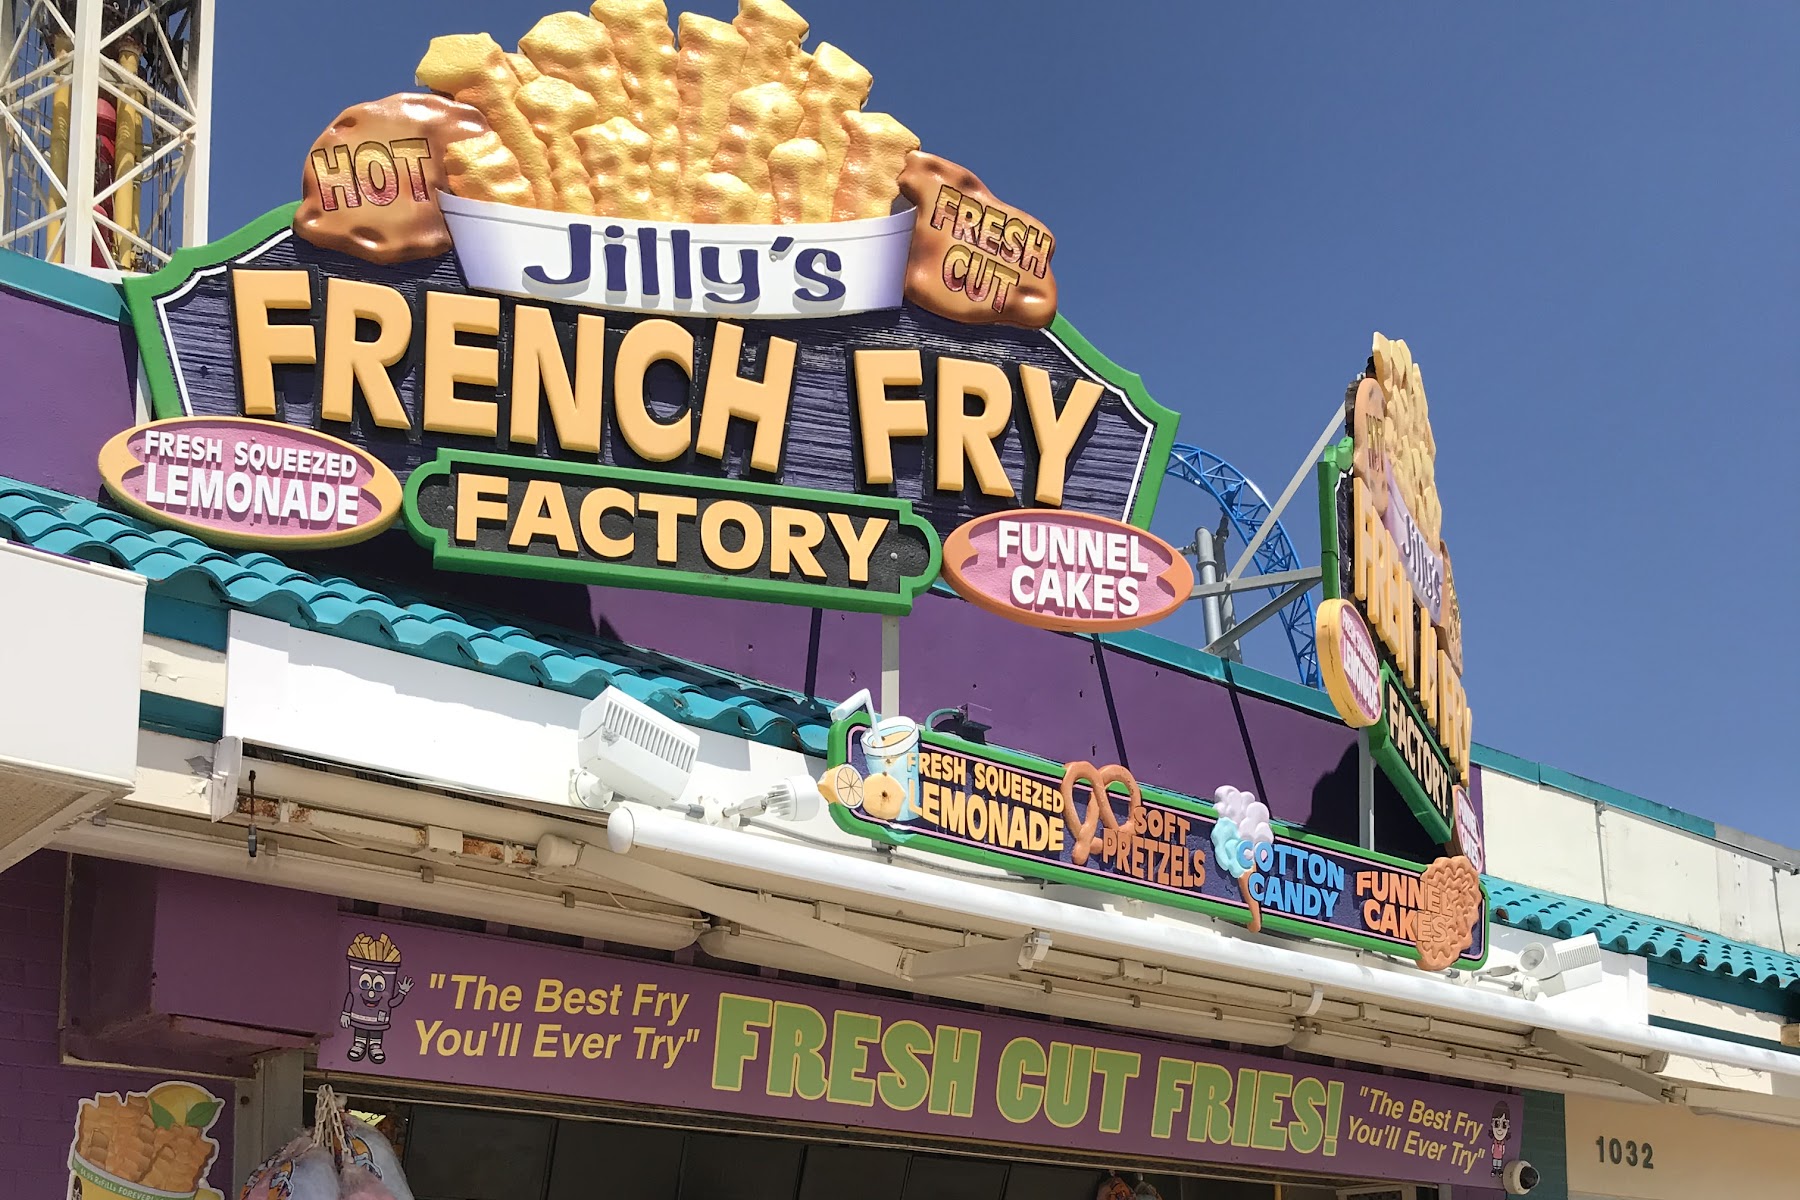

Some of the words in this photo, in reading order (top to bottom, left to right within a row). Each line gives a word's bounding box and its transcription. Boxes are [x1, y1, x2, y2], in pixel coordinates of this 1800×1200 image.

[311, 137, 432, 212] HOT
[930, 184, 1053, 280] FRESH
[523, 222, 847, 304] Jilly's
[942, 243, 1020, 314] CUT
[232, 268, 798, 474] FRENCH
[854, 349, 1105, 507] FRY
[144, 430, 223, 464] FRESH
[234, 440, 358, 480] SQUEEZED
[144, 461, 360, 526] LEMONADE
[455, 472, 890, 583] FACTORY
[998, 519, 1150, 574] FUNNEL
[1010, 569, 1140, 615] CAKES
[1388, 683, 1447, 818] FACTORY
[907, 752, 967, 787] FRESH
[974, 762, 1065, 815] SQUEEZED
[908, 779, 1065, 852] LEMONADE
[1134, 805, 1191, 846] SOFT
[1102, 827, 1206, 888] PRETZELS
[1237, 839, 1344, 892] COTTON
[1249, 872, 1340, 918] CANDY
[1356, 871, 1454, 918] FUNNEL
[1363, 899, 1448, 943] CAKES
[534, 978, 624, 1017] Best
[631, 983, 689, 1027] Fry
[414, 1019, 523, 1058] You'll
[532, 1023, 622, 1060] Ever
[711, 991, 982, 1119] FRESH
[996, 1036, 1142, 1134] CUT
[1151, 1056, 1345, 1158] FRIES!
[1346, 1115, 1402, 1151] You'll
[1403, 1131, 1448, 1163] Ever
[1407, 1099, 1452, 1133] Best
[1454, 1111, 1484, 1143] Fry
[1595, 1135, 1654, 1170] 1032
